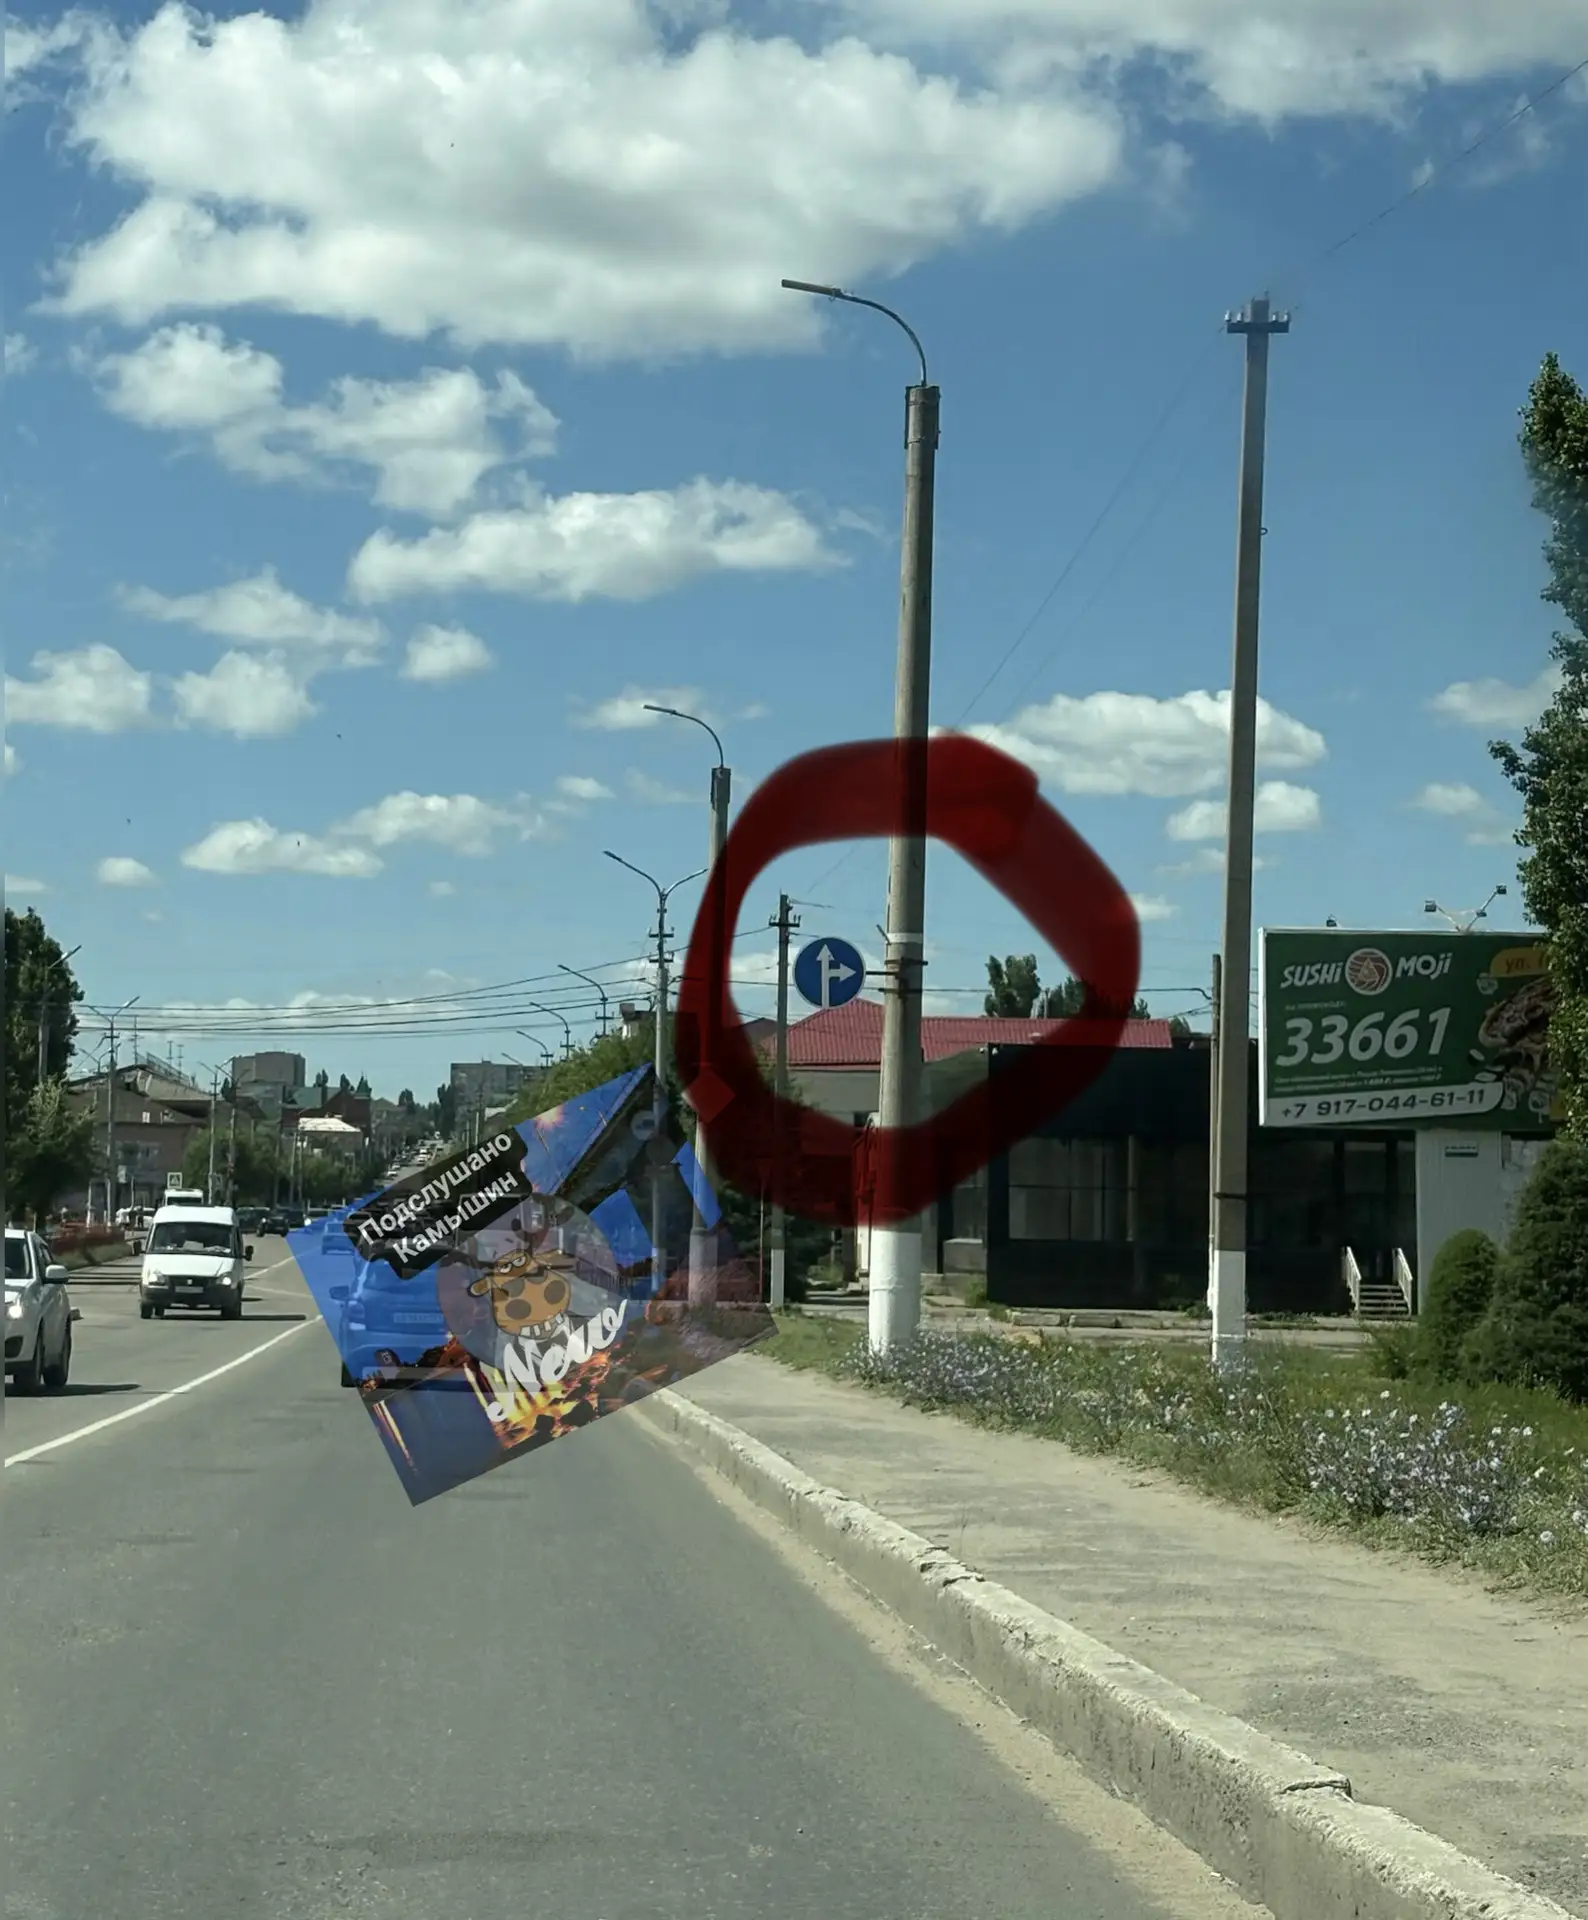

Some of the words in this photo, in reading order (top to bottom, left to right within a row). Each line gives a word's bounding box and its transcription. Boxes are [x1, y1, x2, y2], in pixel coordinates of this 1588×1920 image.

[1275, 1007, 1451, 1067] 33661
[1282, 1103, 1307, 1119] +7
[1317, 1089, 1485, 1116] 917-044-61-11
